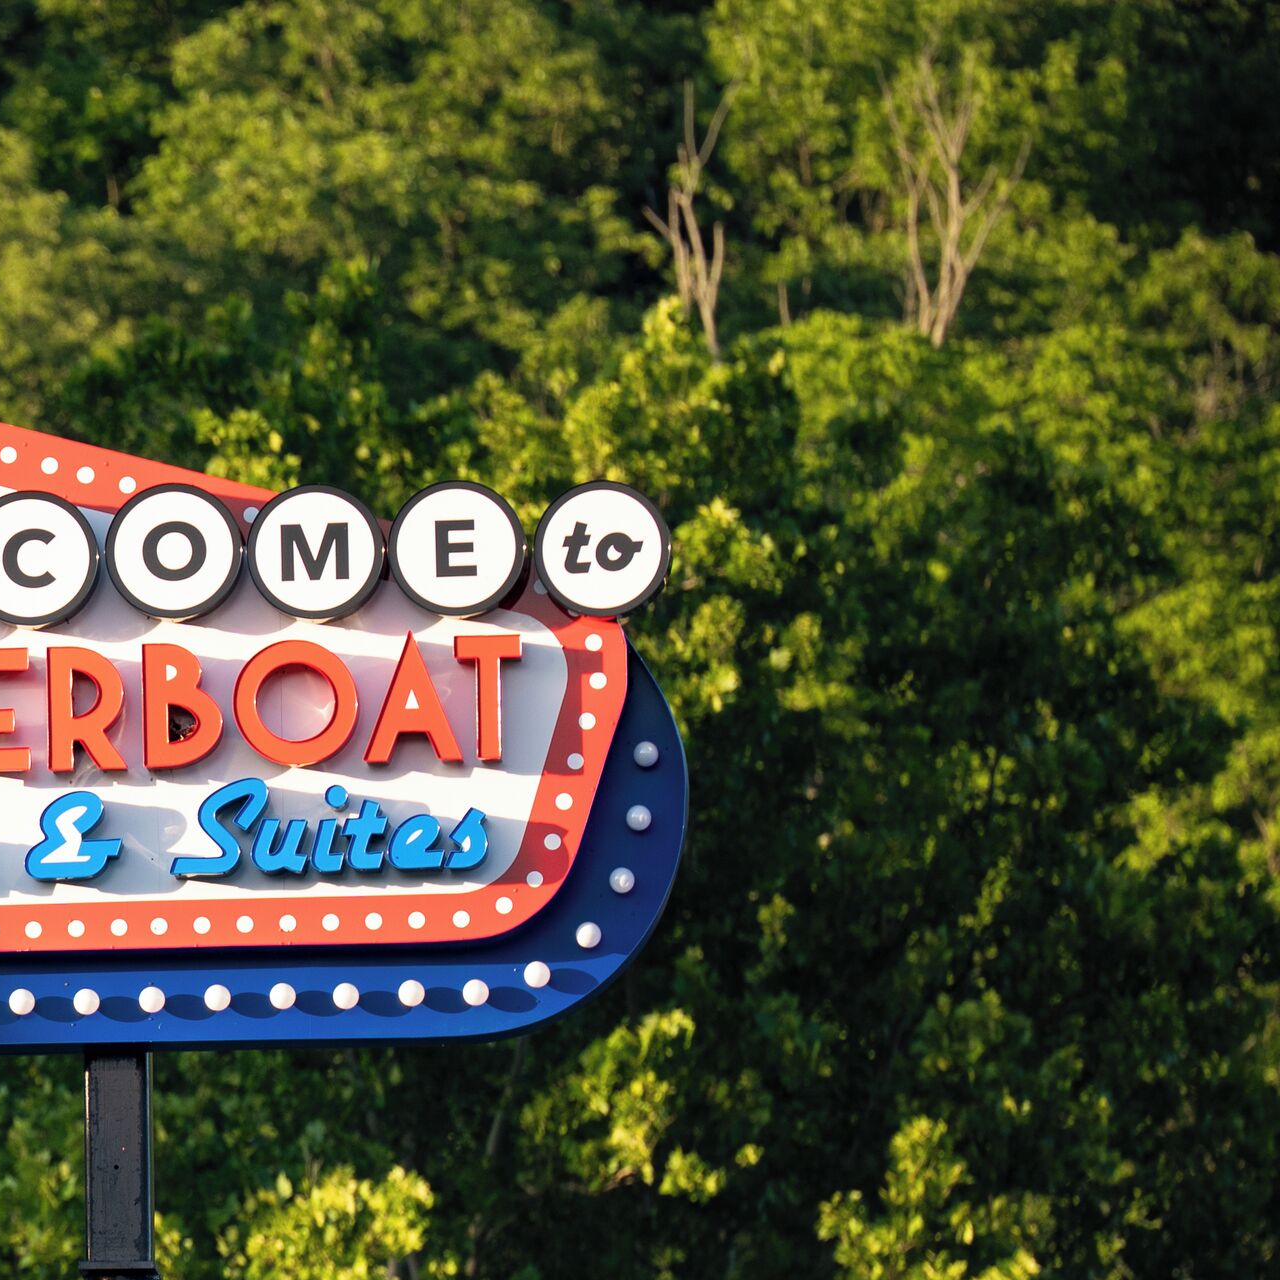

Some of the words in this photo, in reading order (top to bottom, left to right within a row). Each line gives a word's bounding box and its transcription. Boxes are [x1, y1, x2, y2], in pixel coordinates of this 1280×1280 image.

[562, 521, 643, 575] to
[24, 790, 122, 882] &
[171, 776, 489, 877] Suites
